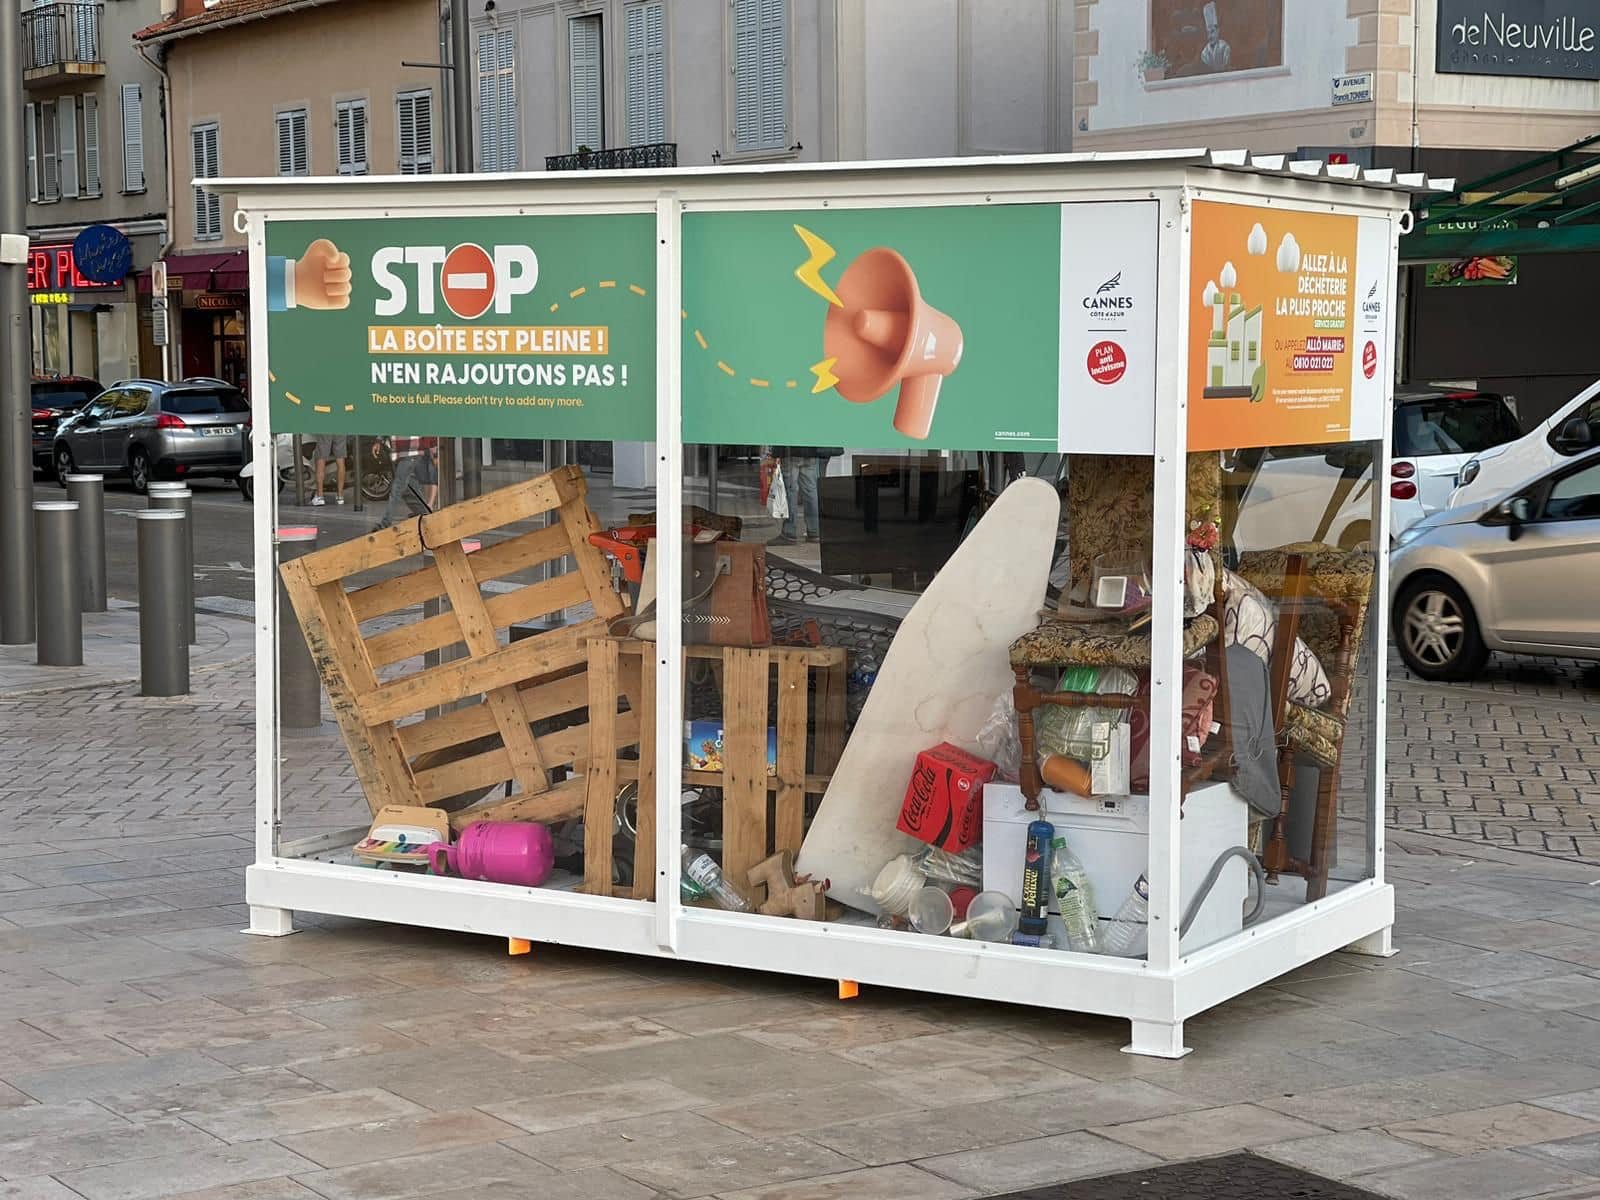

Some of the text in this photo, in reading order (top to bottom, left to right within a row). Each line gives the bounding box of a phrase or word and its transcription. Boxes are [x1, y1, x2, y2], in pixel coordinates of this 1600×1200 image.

[1342, 77, 1367, 87] AVENUE
[1302, 250, 1348, 274] ALLEZ À LA
[371, 243, 539, 319] STOP
[1083, 297, 1133, 309] CANNES
[1276, 297, 1346, 318] LA PLUS PROCHE
[1362, 301, 1381, 312] CANNES
[370, 323, 604, 352] LA BOÎTE EST PLEINE !
[1095, 345, 1114, 357] PLAN
[1099, 354, 1114, 365] anti
[1311, 357, 1321, 369] 021
[1322, 358, 1333, 369] 022
[371, 362, 628, 387] N'EN RAJOUTONS PAS !
[372, 393, 584, 409] The box is full. Please don't try to add any more.
[1027, 870, 1039, 907] Deluxe
